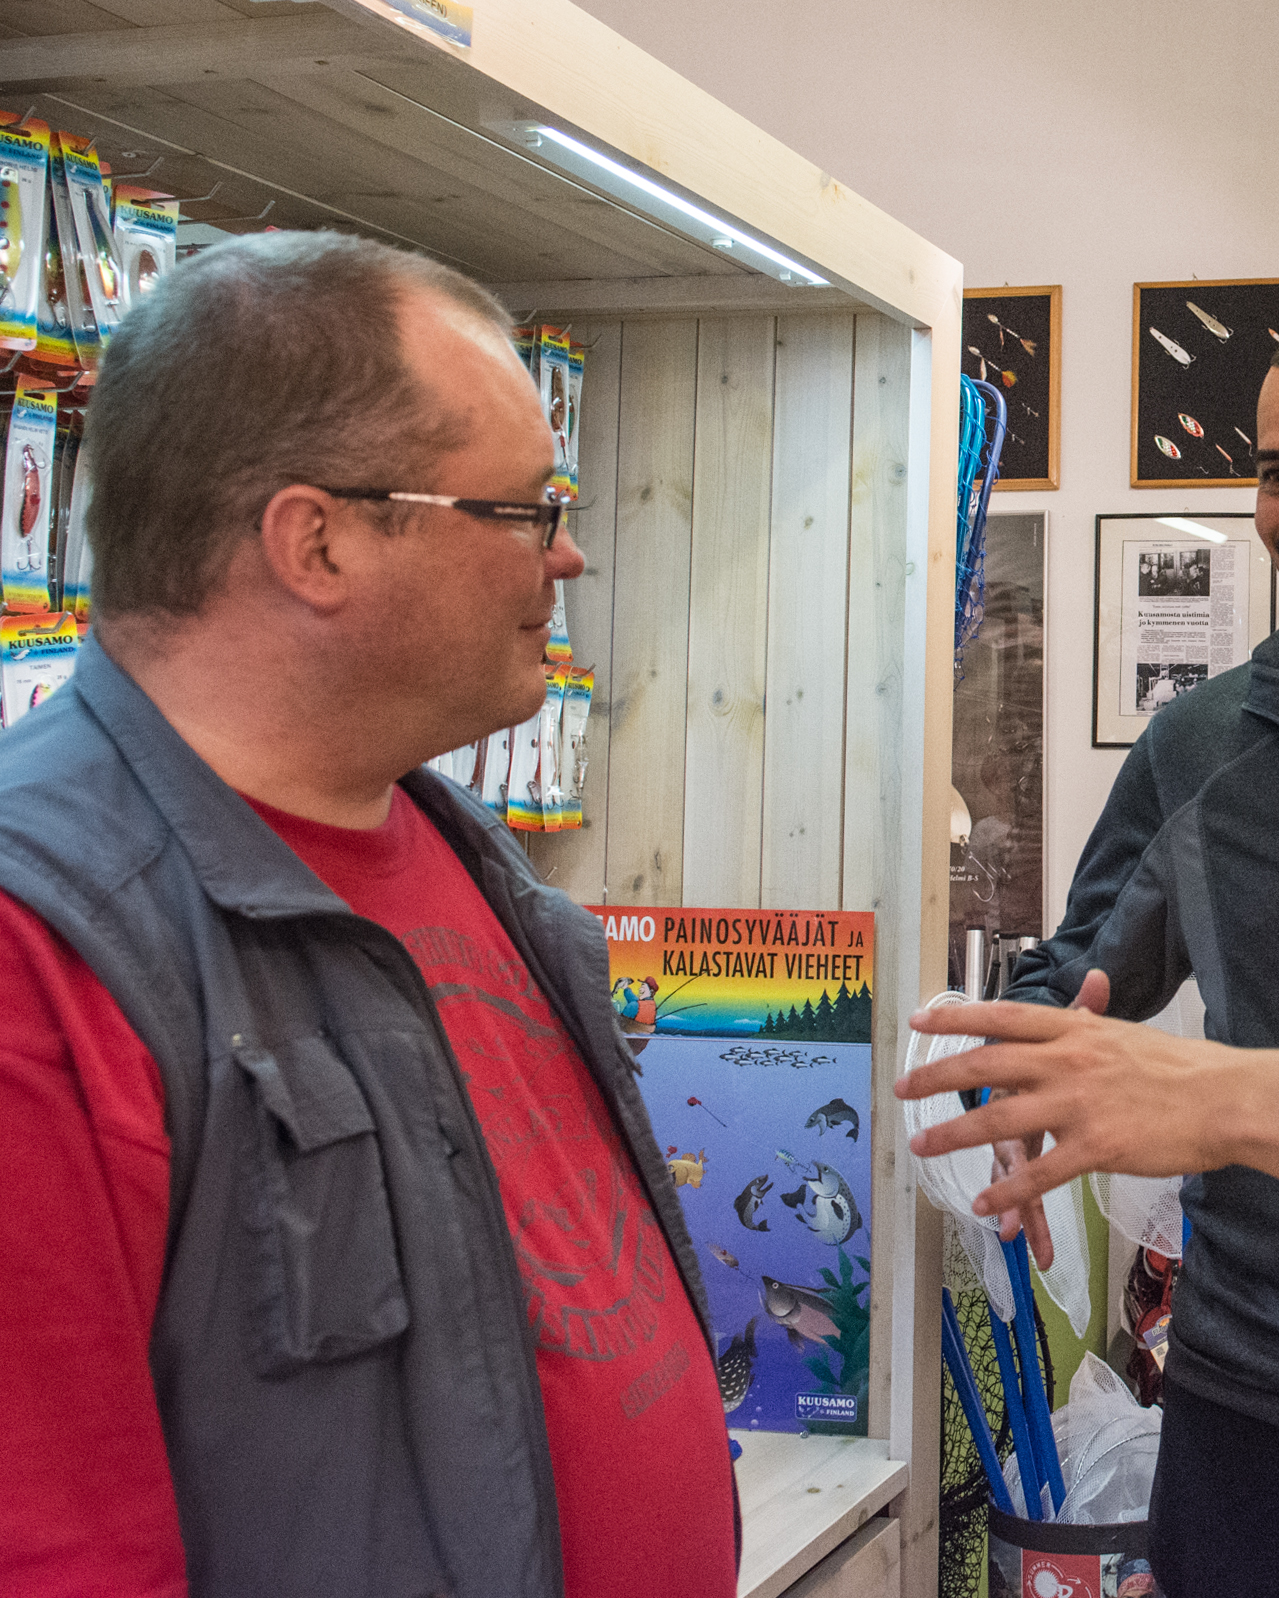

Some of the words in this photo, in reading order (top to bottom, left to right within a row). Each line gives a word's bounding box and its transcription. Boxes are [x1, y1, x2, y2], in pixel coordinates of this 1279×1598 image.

[120, 205, 175, 225] KUUSAMO
[17, 397, 55, 414] KUUSAMO
[1147, 619, 1185, 627] kymmenen
[9, 635, 74, 649] KUUSAMO
[41, 647, 75, 655] FINLAND
[664, 912, 839, 948] PAINOSYVÄÄJÄT
[847, 930, 864, 948] JA
[662, 950, 778, 979] KALASTAVAT
[785, 952, 864, 981] VIEHEET
[798, 1396, 855, 1408] KUUSAMO
[826, 1409, 855, 1417] FINLAND
[1027, 1561, 1051, 1580] SUMMER
